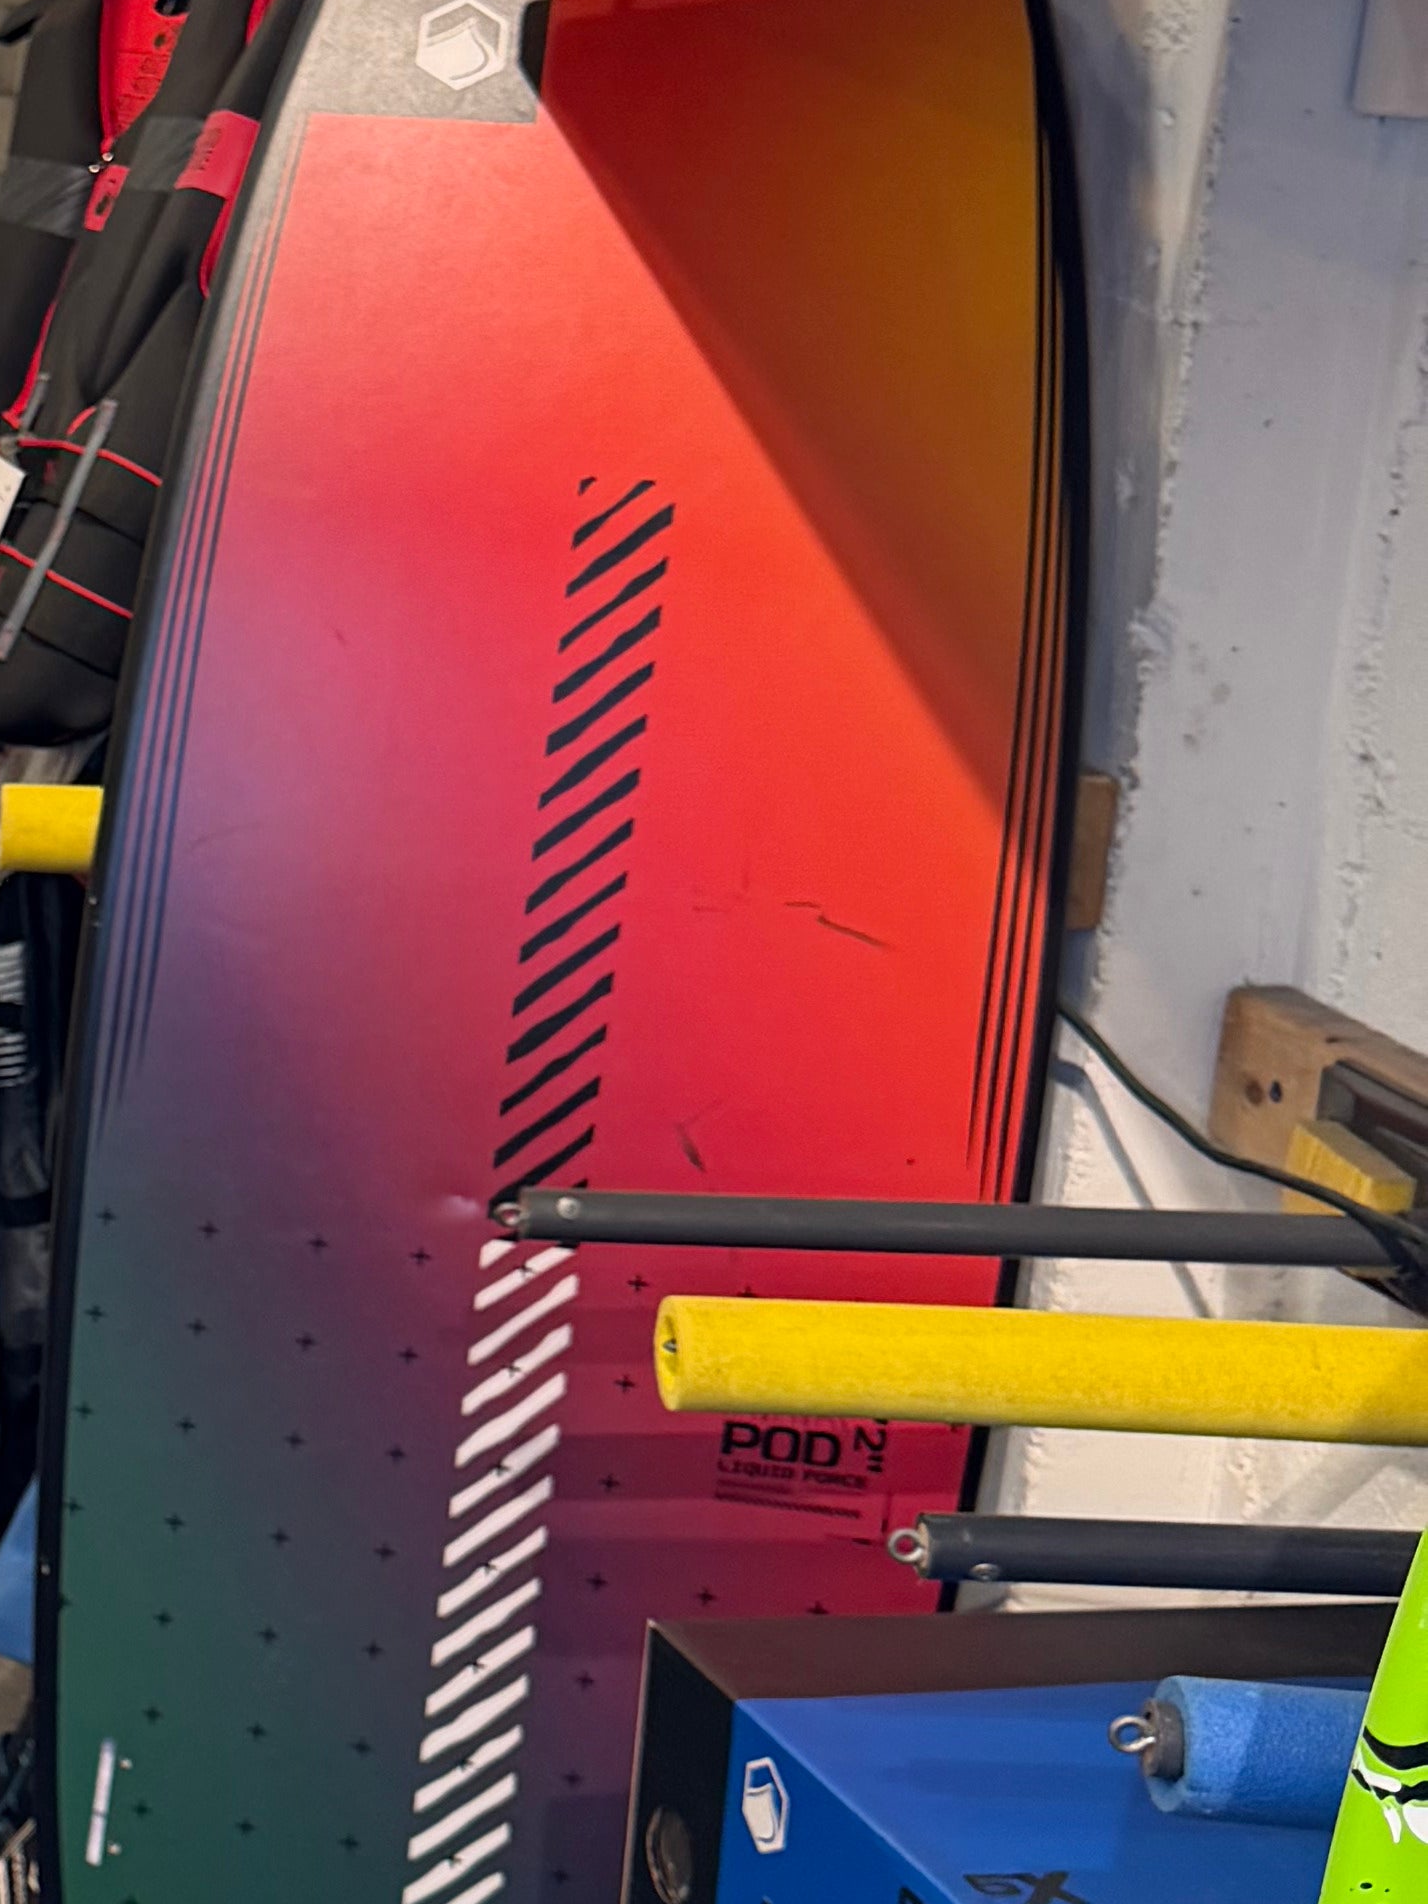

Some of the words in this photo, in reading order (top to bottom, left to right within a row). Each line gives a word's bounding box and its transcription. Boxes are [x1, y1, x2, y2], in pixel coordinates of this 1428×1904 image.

[721, 1421, 842, 1467] POD
[718, 1460, 794, 1480] LIQUID
[802, 1469, 867, 1489] FORCE
